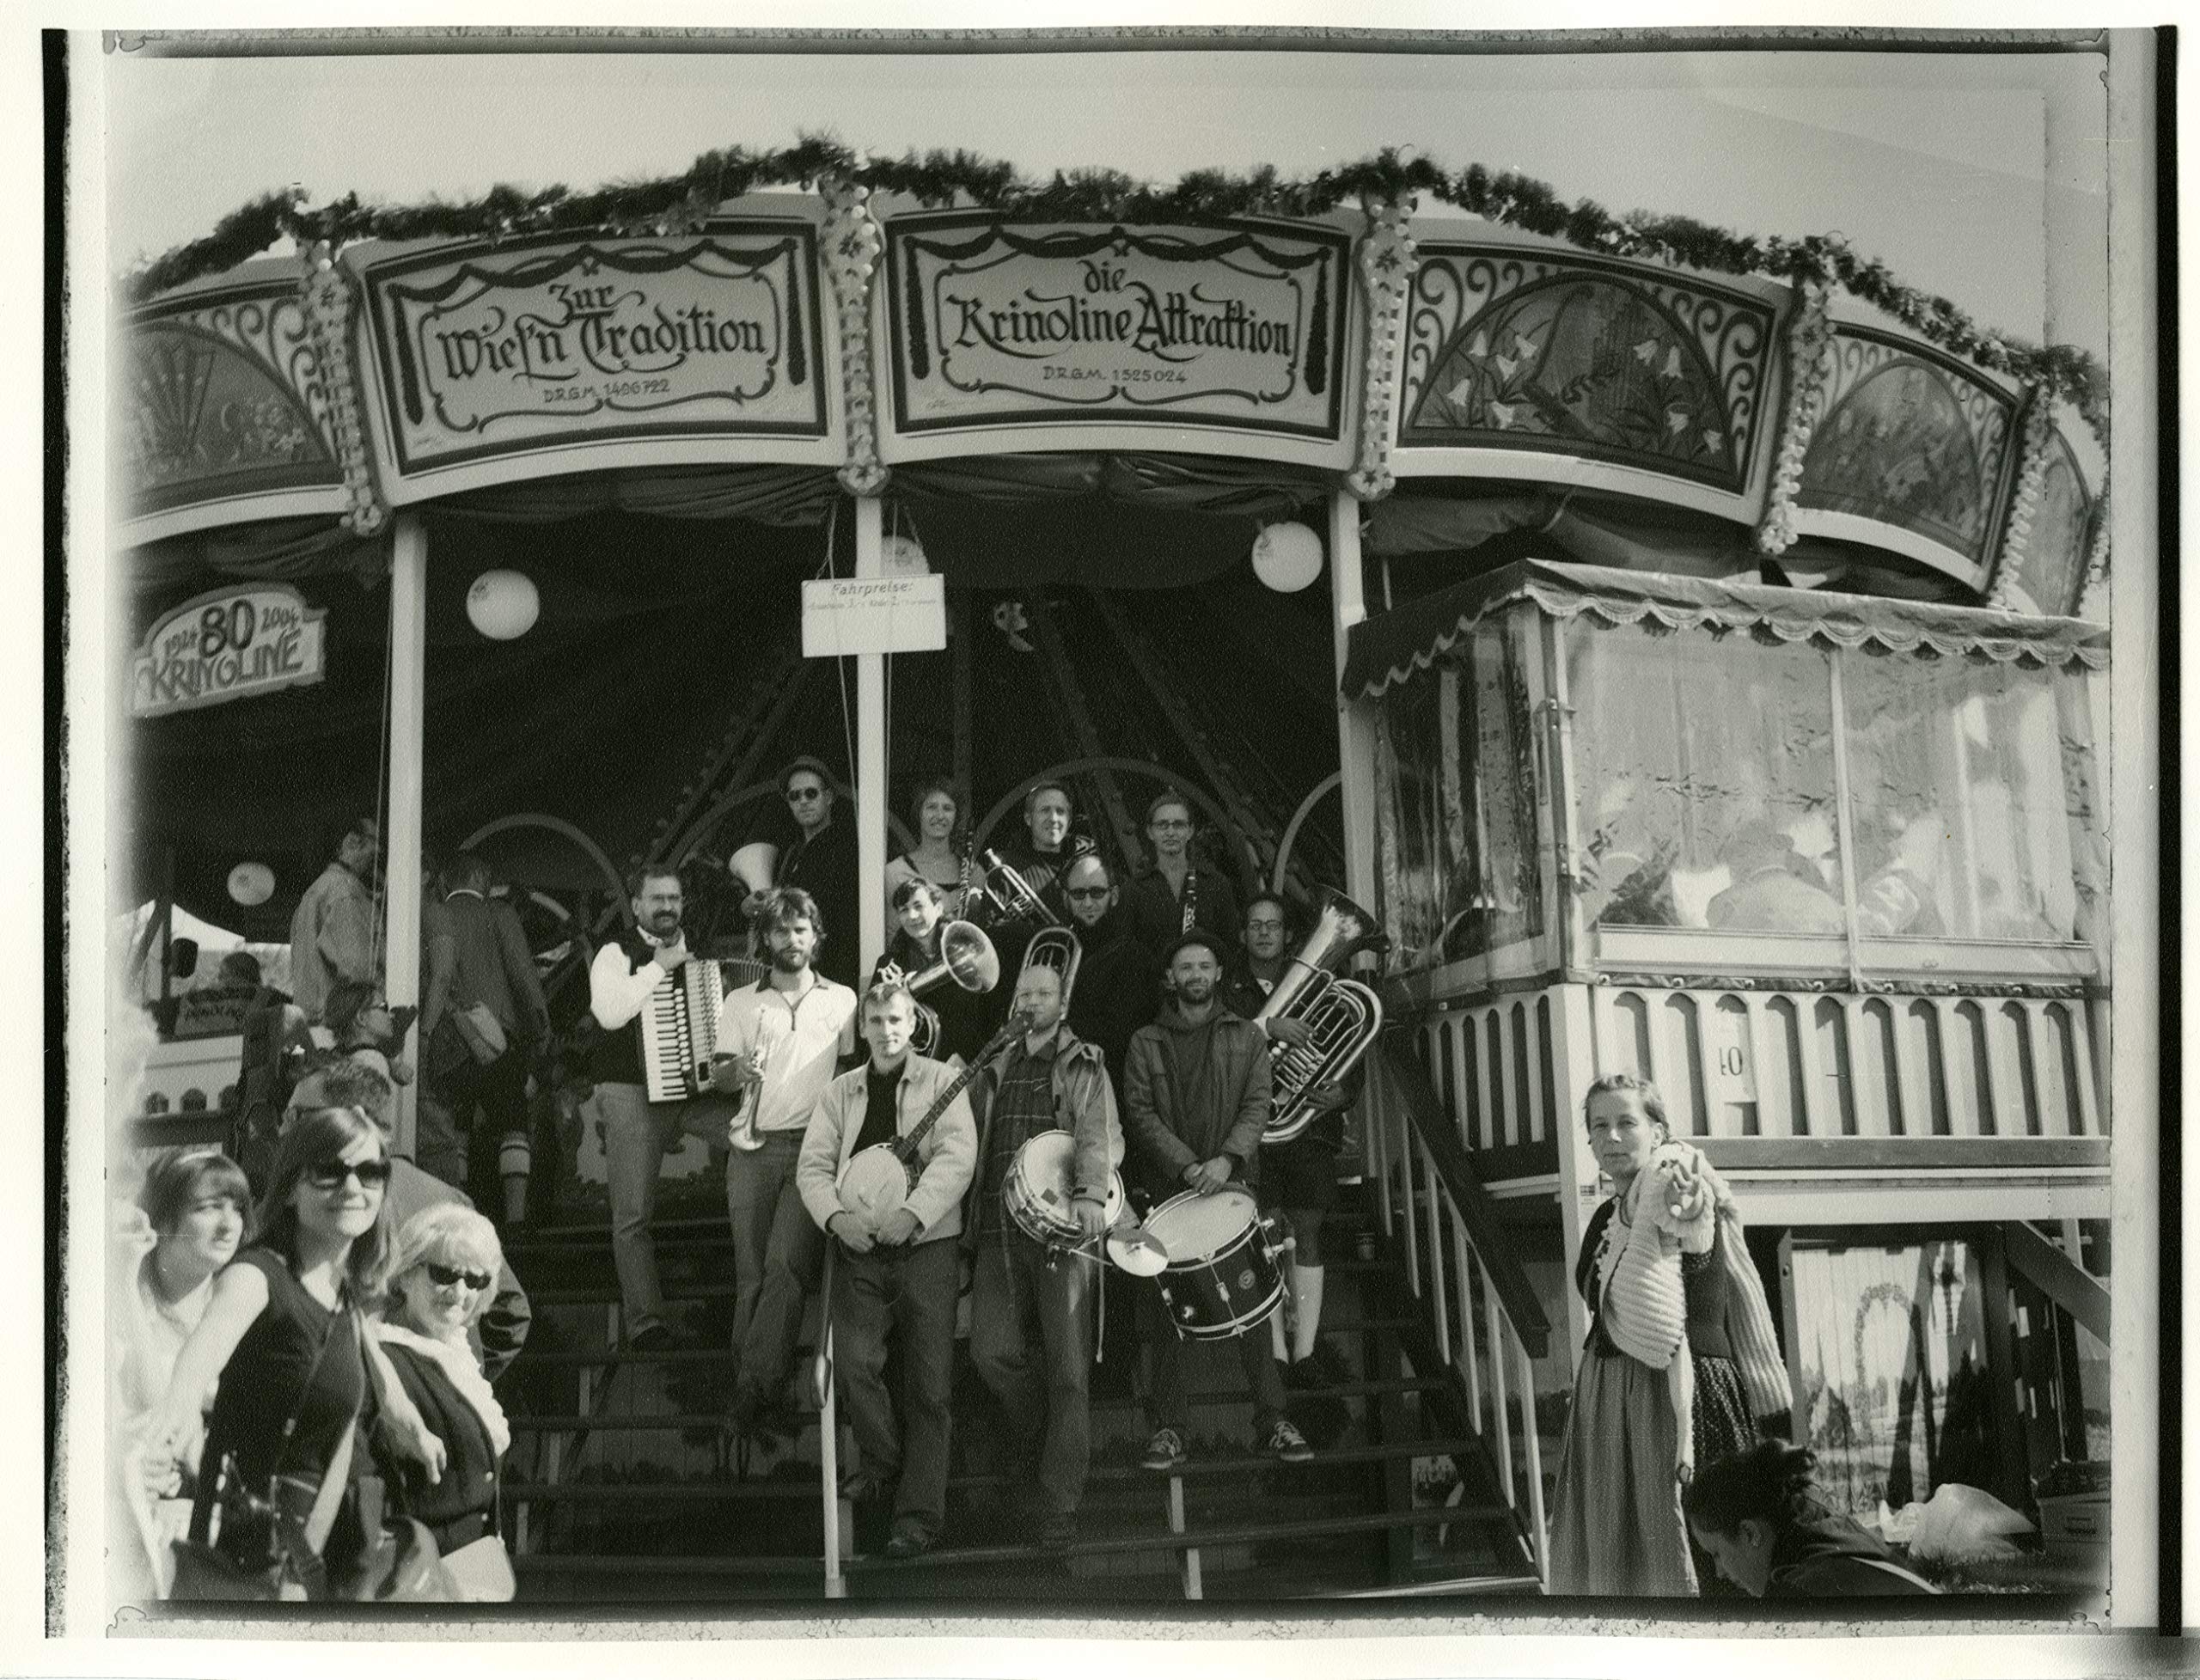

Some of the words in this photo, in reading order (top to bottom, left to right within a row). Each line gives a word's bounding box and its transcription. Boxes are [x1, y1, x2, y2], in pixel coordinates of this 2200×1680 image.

[1079, 260, 1126, 293] die
[547, 284, 634, 323] Zur
[945, 289, 1131, 357] Krinoline
[1120, 282, 1292, 363] Attraktion
[580, 302, 768, 374] Tradition
[1113, 368, 1189, 384] 1525024
[199, 598, 255, 659] 80
